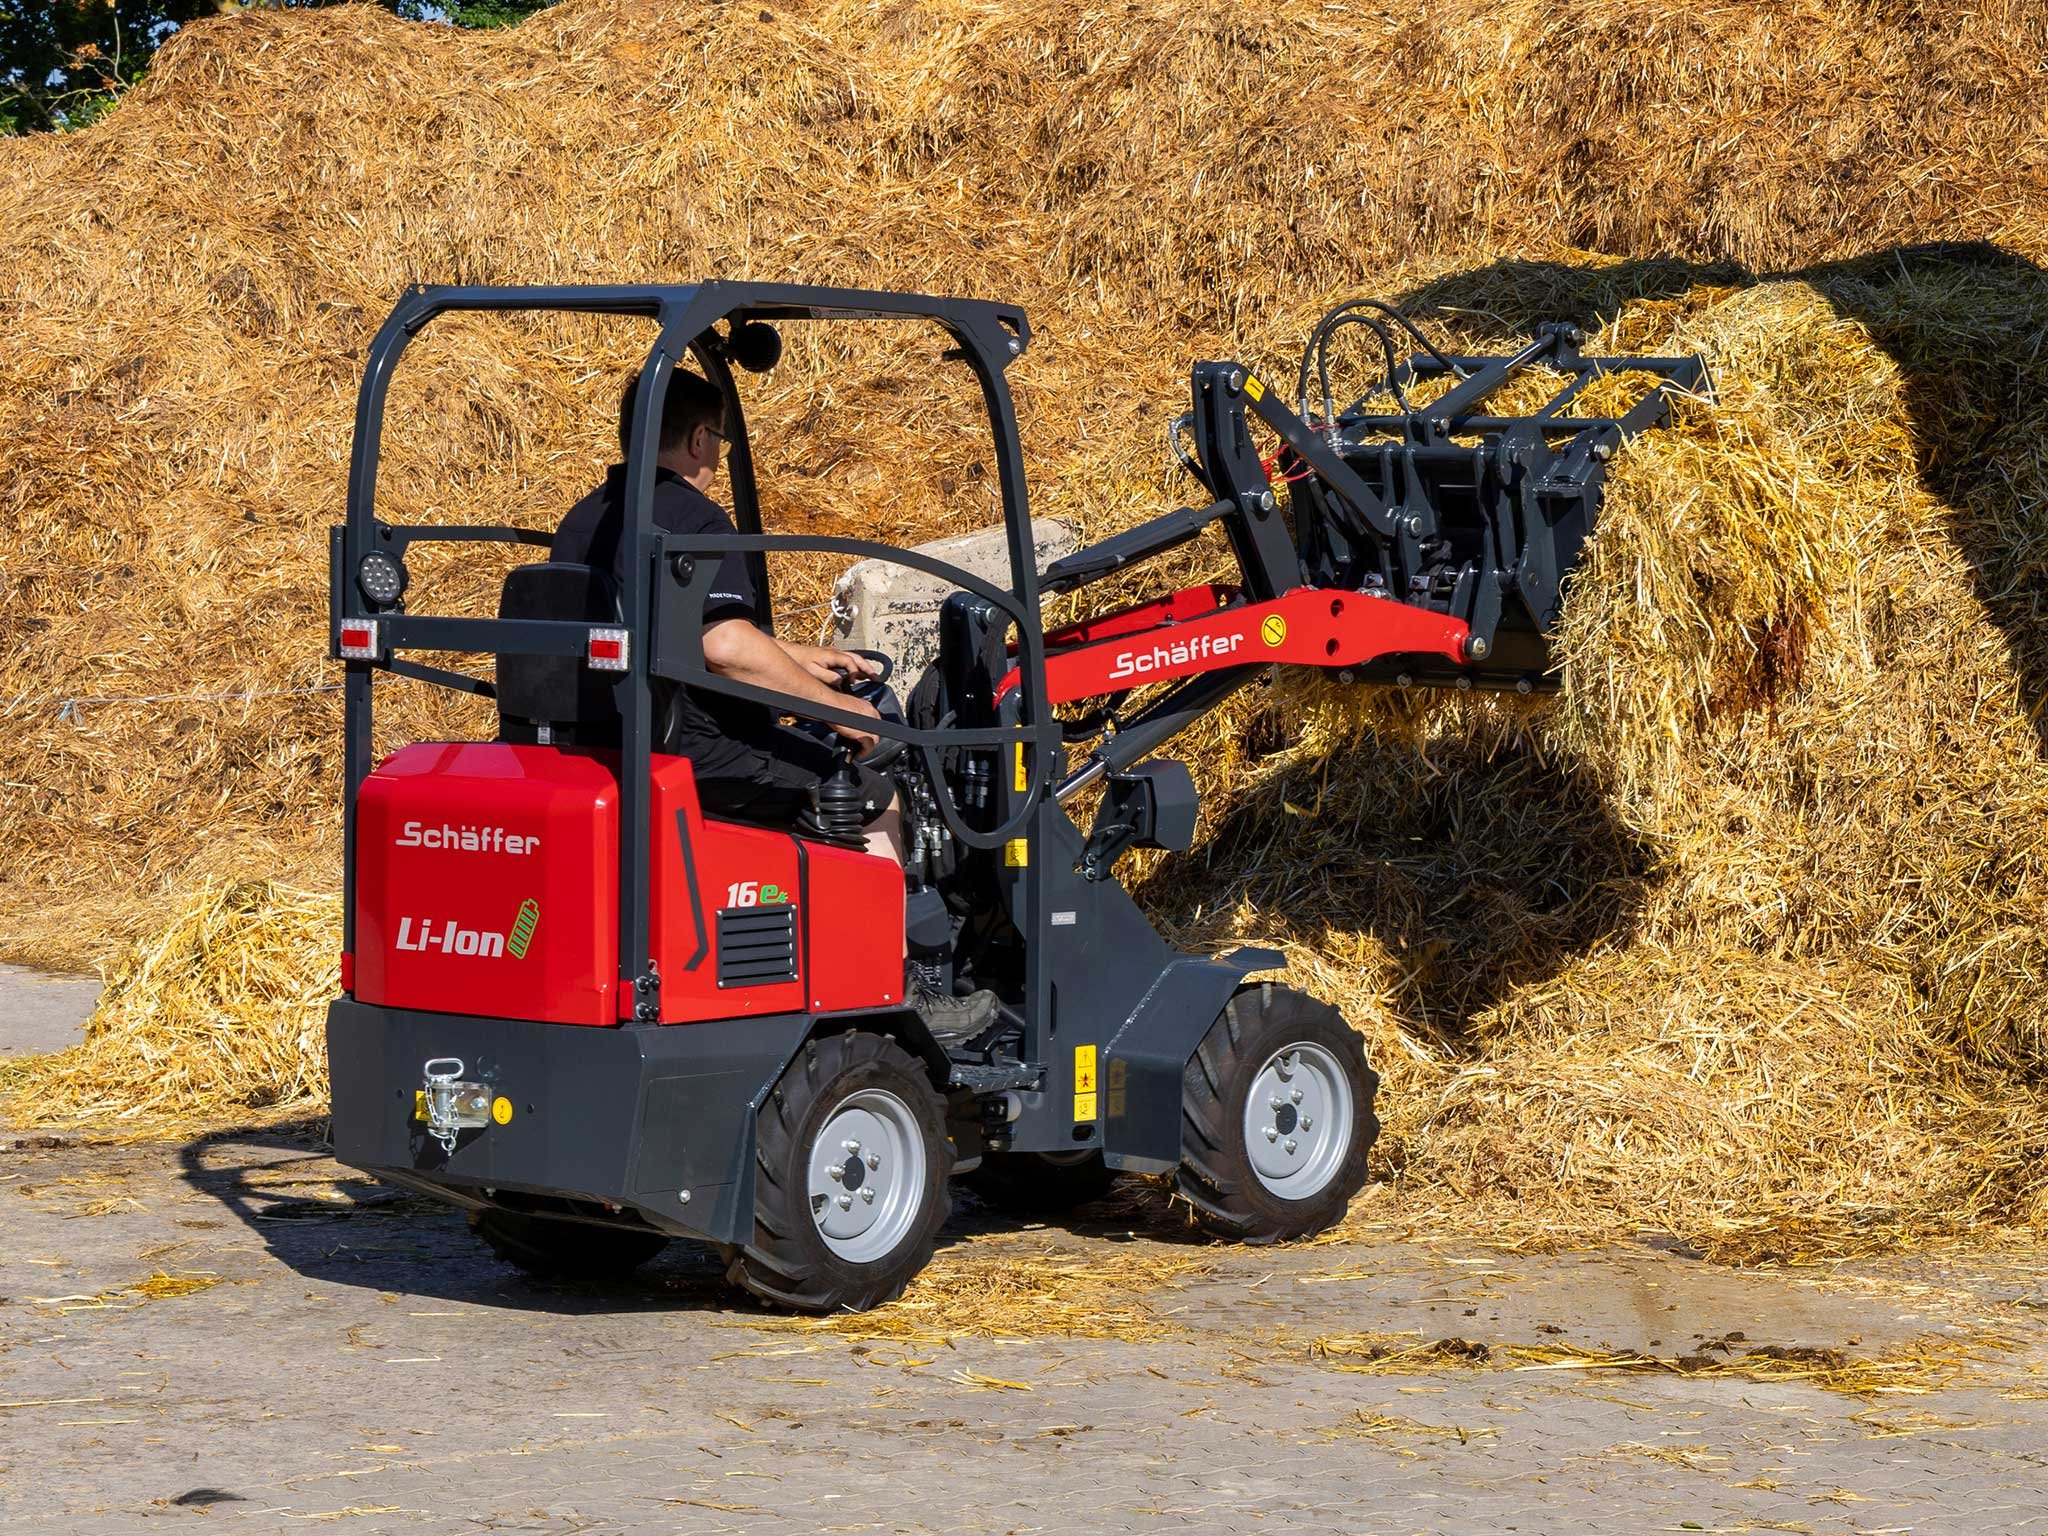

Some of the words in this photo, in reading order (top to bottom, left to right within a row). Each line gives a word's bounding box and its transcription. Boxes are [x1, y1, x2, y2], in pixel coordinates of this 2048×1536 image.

[1108, 633, 1245, 679] Schäffer
[395, 821, 540, 855] Schäffer
[395, 917, 504, 958] Li-Ion
